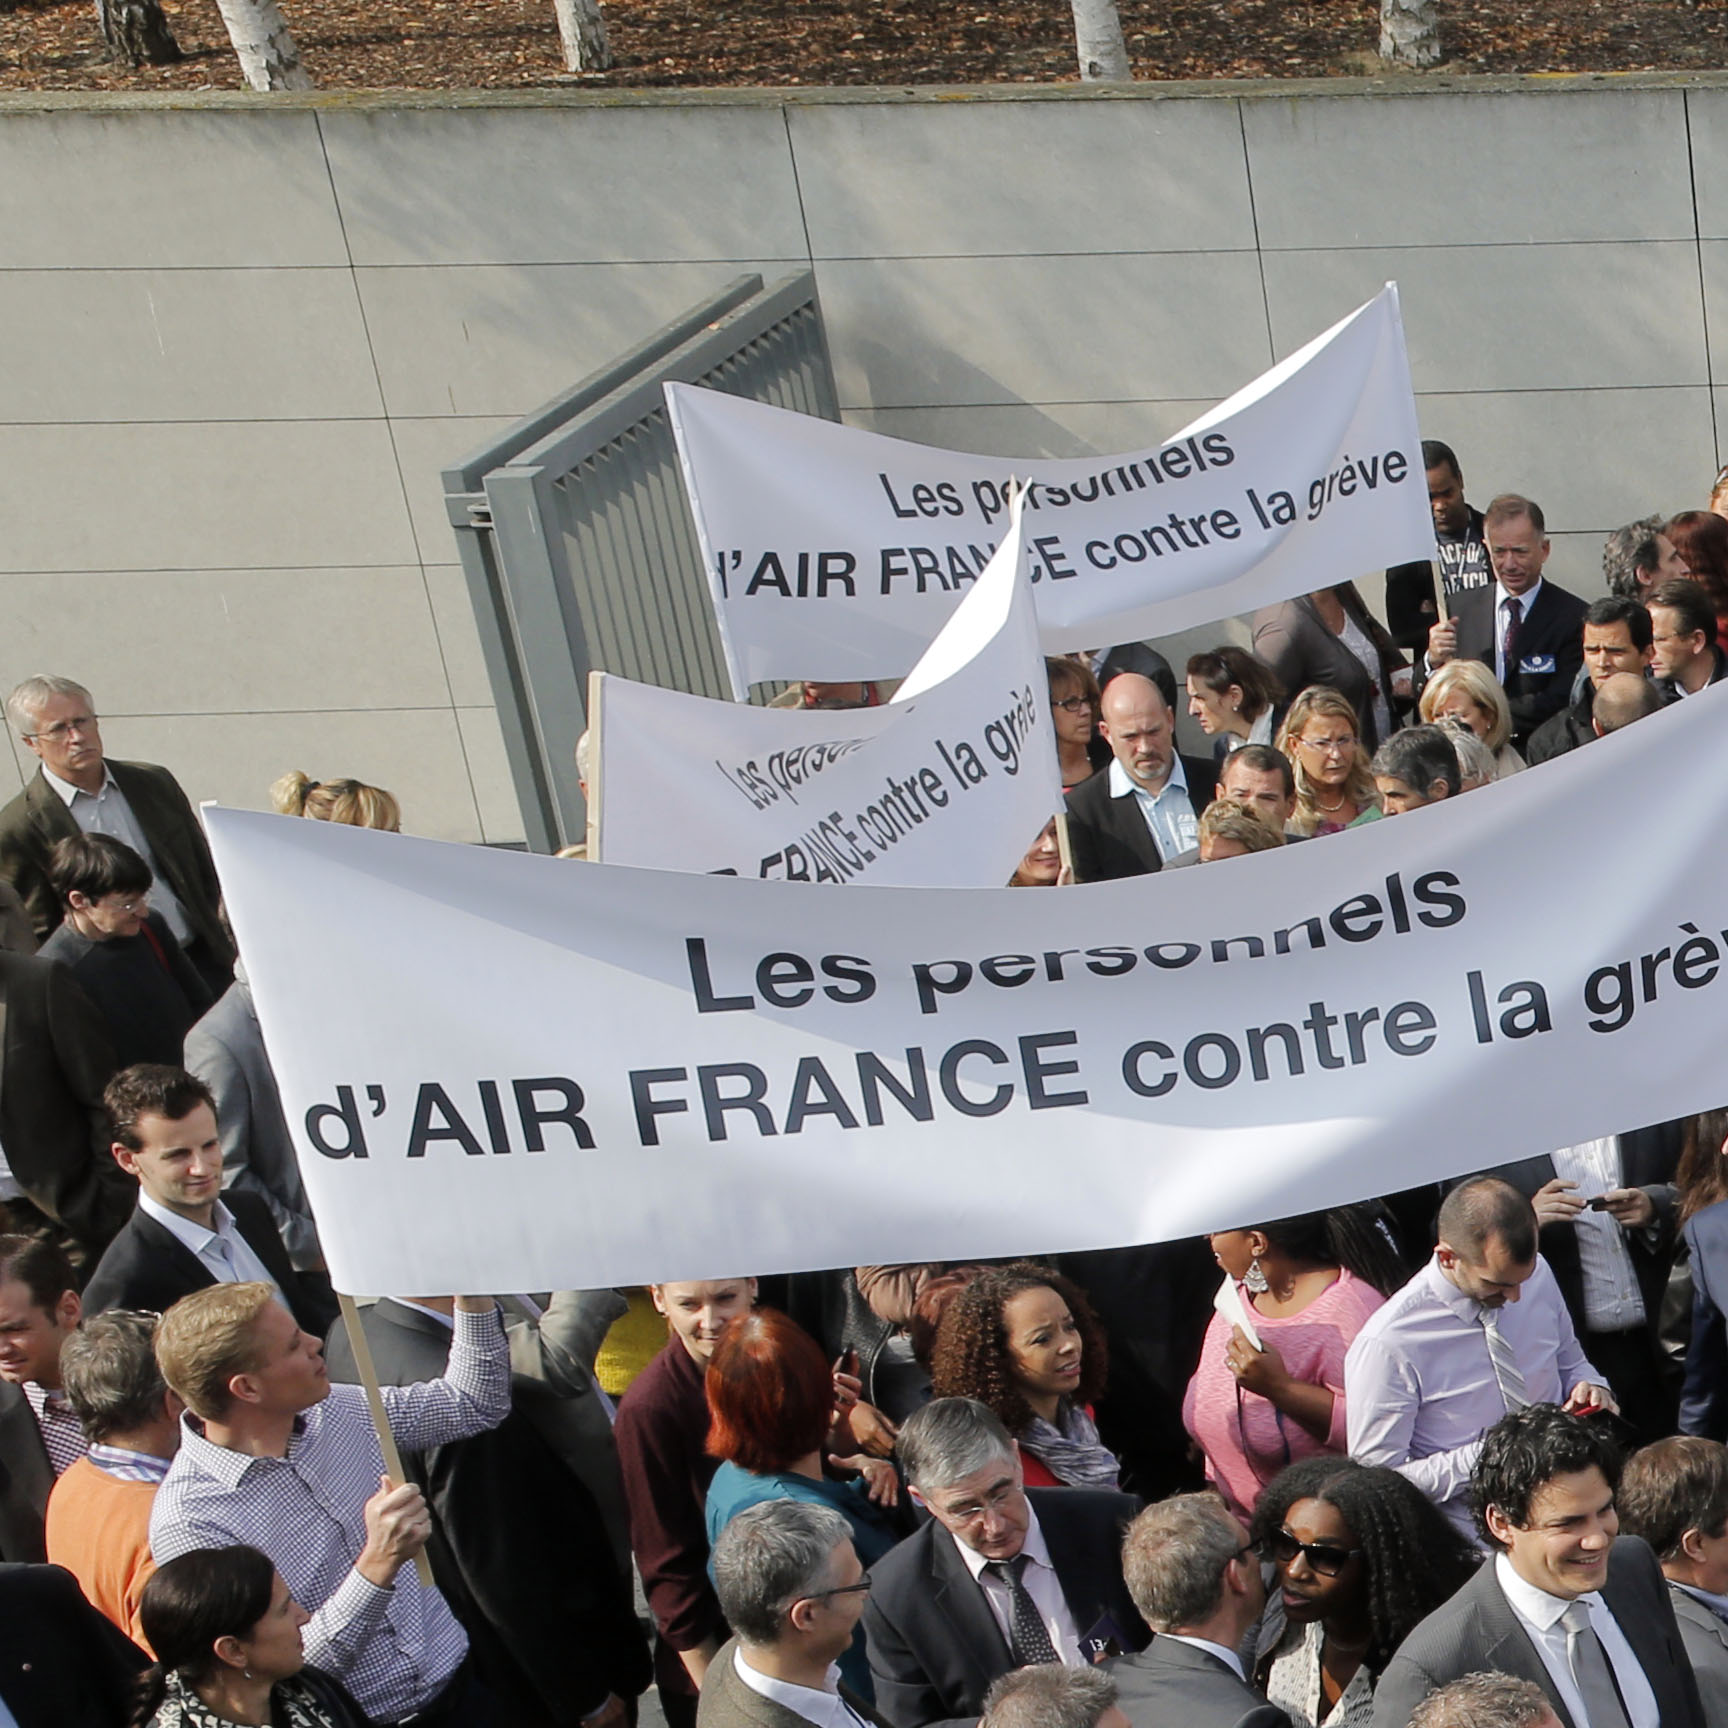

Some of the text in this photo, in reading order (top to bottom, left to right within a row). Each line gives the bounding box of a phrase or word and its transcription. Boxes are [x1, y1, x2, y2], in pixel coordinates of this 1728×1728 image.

[879, 473, 964, 518] Les
[1085, 508, 1241, 570] contre
[1247, 488, 1296, 529] la
[1308, 450, 1408, 520] grève
[716, 760, 779, 810] Les
[857, 767, 948, 850] contre
[935, 740, 988, 790] la
[685, 870, 1466, 1014] Les personnels
[304, 1076, 596, 1159] d'AIR
[628, 1030, 1089, 1146] FRANCE
[1122, 1001, 1437, 1098] contre
[1467, 970, 1552, 1044] la
